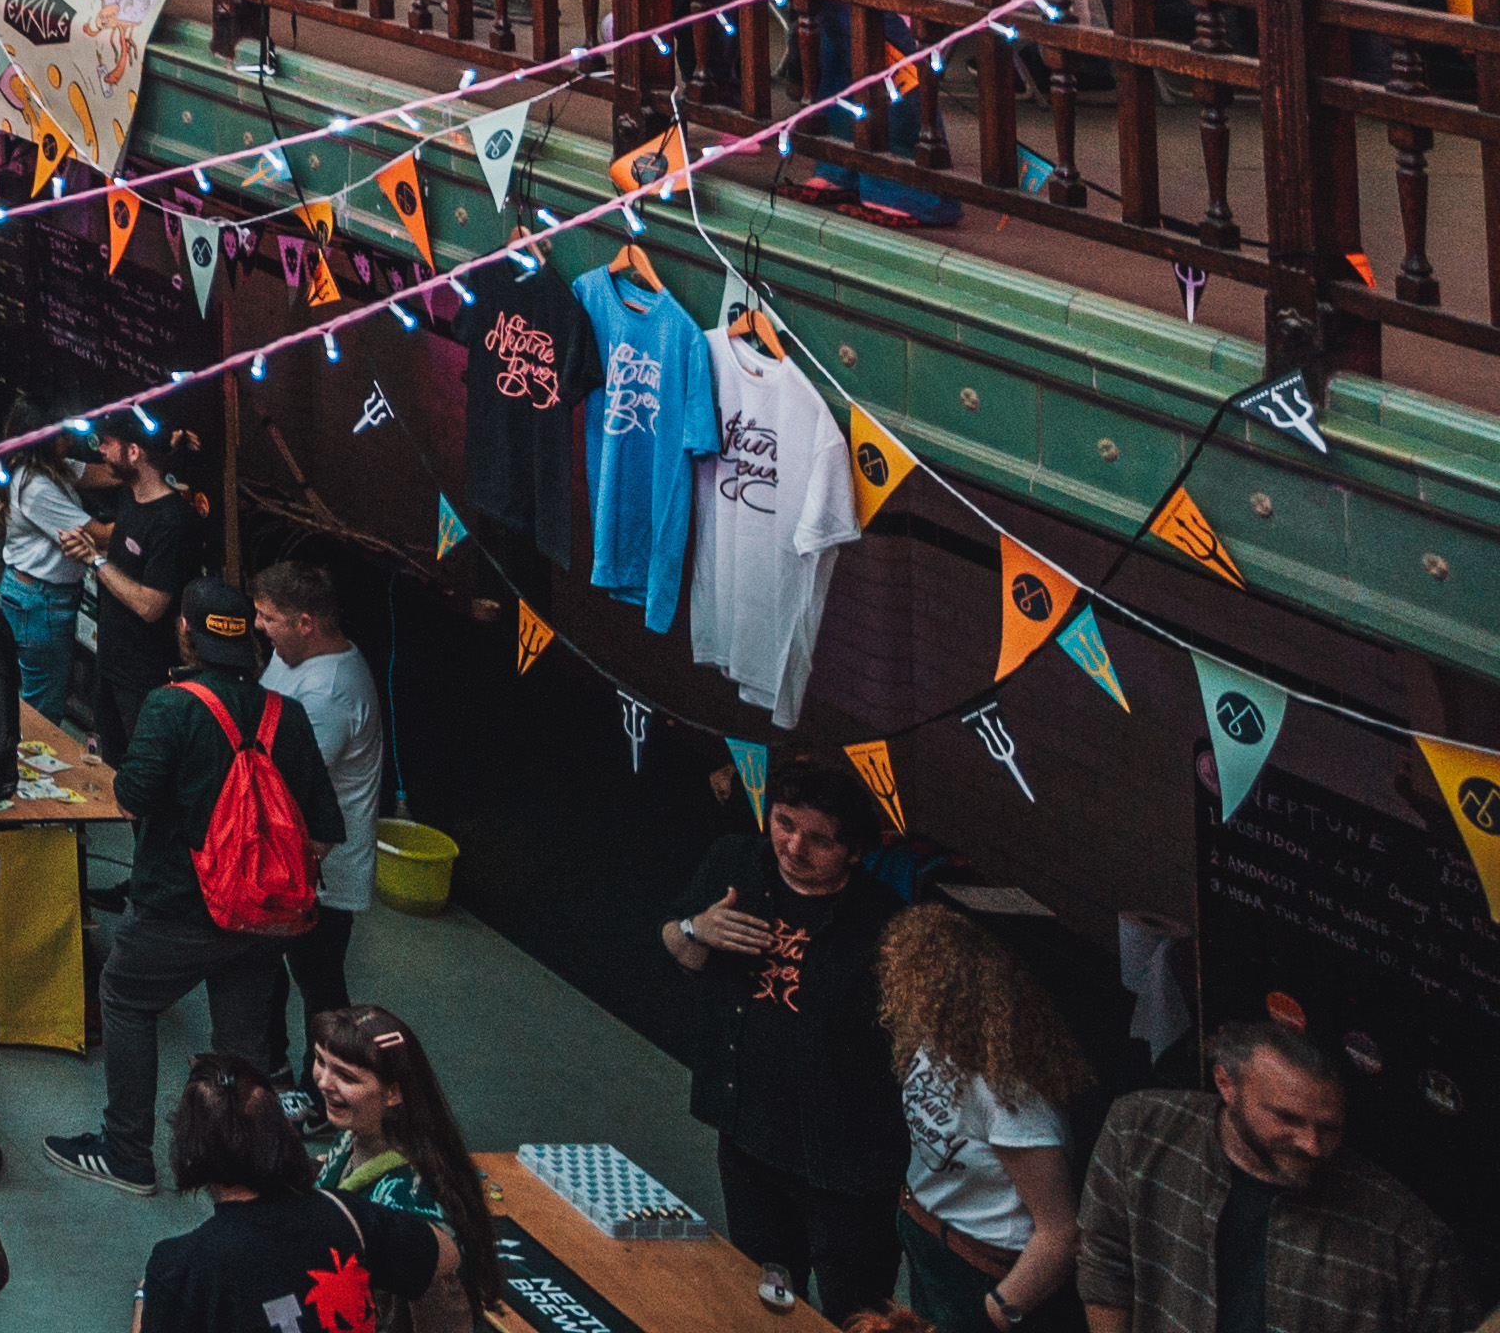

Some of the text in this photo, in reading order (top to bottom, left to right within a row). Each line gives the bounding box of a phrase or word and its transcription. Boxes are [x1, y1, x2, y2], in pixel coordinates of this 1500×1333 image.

[1227, 814, 1310, 862] POSEIDON
[1227, 854, 1299, 895] AMONGST
[1308, 888, 1334, 911] THE
[1339, 903, 1390, 937] WAVES
[1227, 884, 1267, 912] HEAR
[1273, 903, 1303, 925] THE
